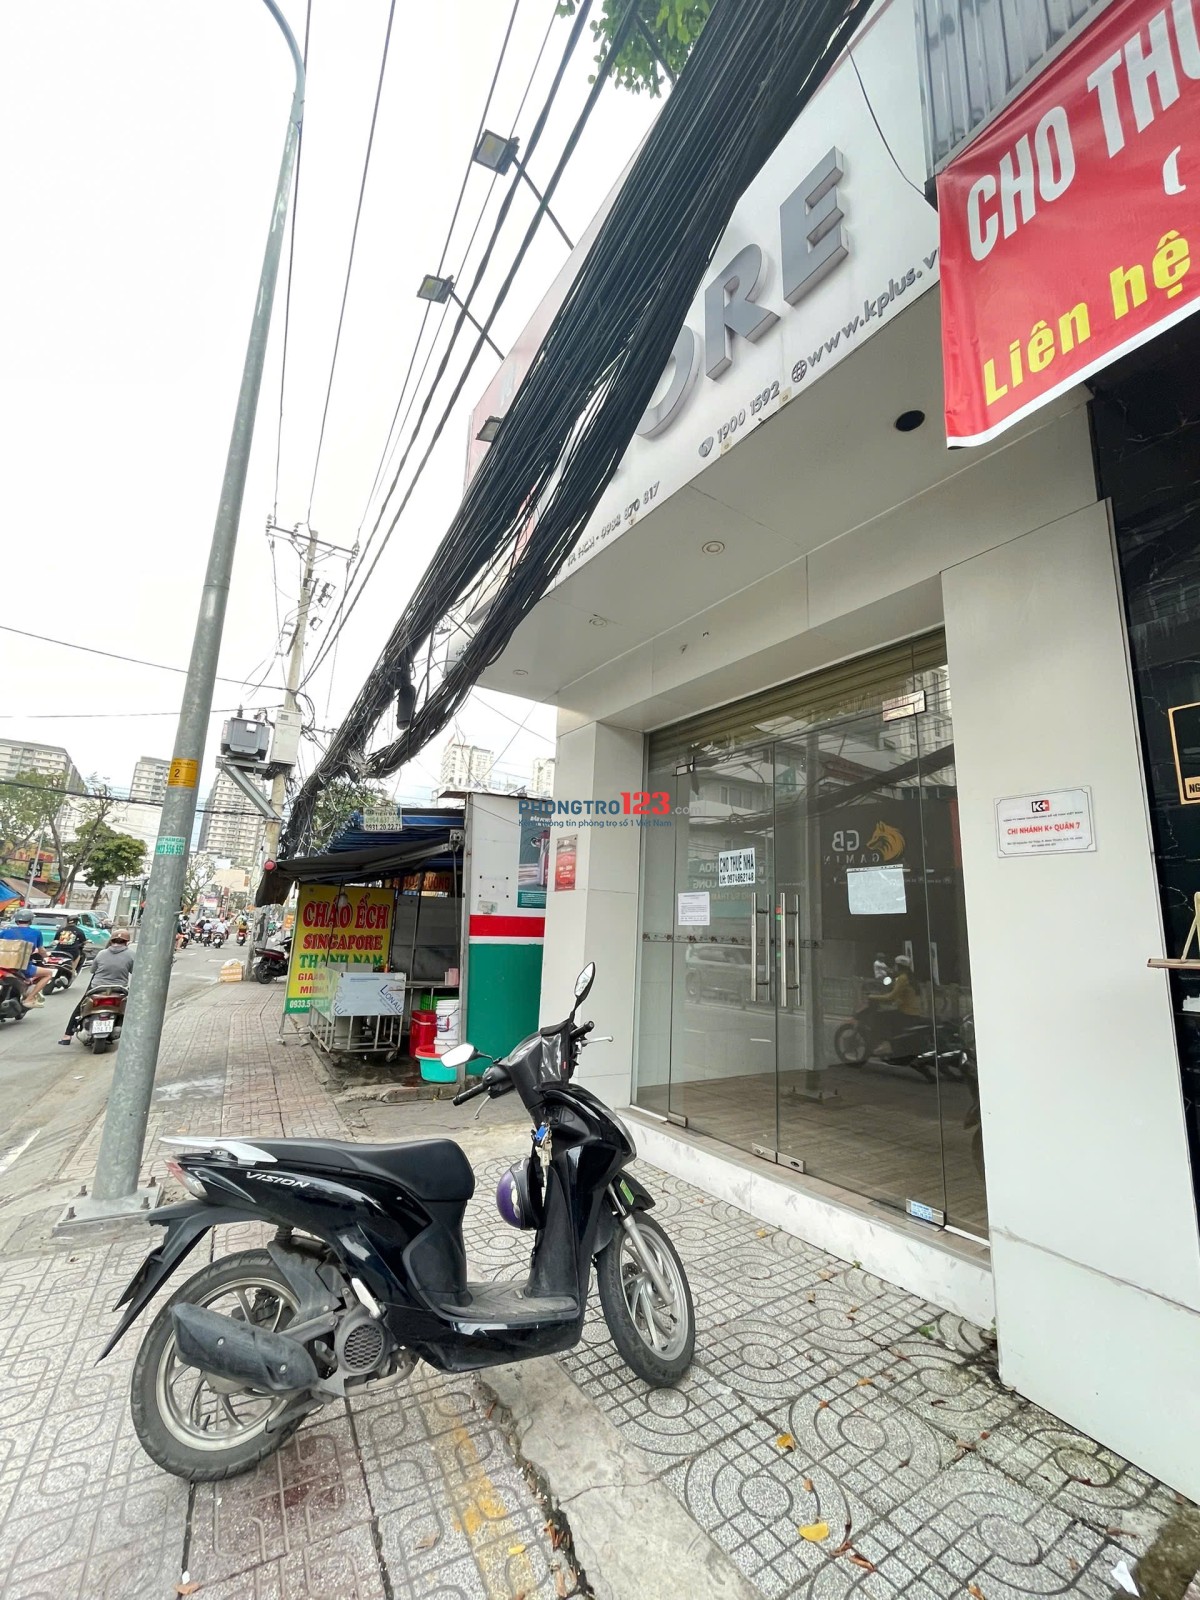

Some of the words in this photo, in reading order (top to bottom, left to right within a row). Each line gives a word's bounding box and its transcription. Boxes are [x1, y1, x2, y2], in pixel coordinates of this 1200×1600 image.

[967, 106, 1076, 262] CHO
[717, 408, 746, 444] 1900
[750, 380, 780, 416] 1592
[807, 246, 940, 368] www.kplus.v
[983, 320, 1091, 407] Liên
[1109, 229, 1191, 321] hệ
[1076, 821, 1081, 829] 7
[302, 933, 384, 951] SINGAPORE
[246, 1171, 311, 1188] VISION
